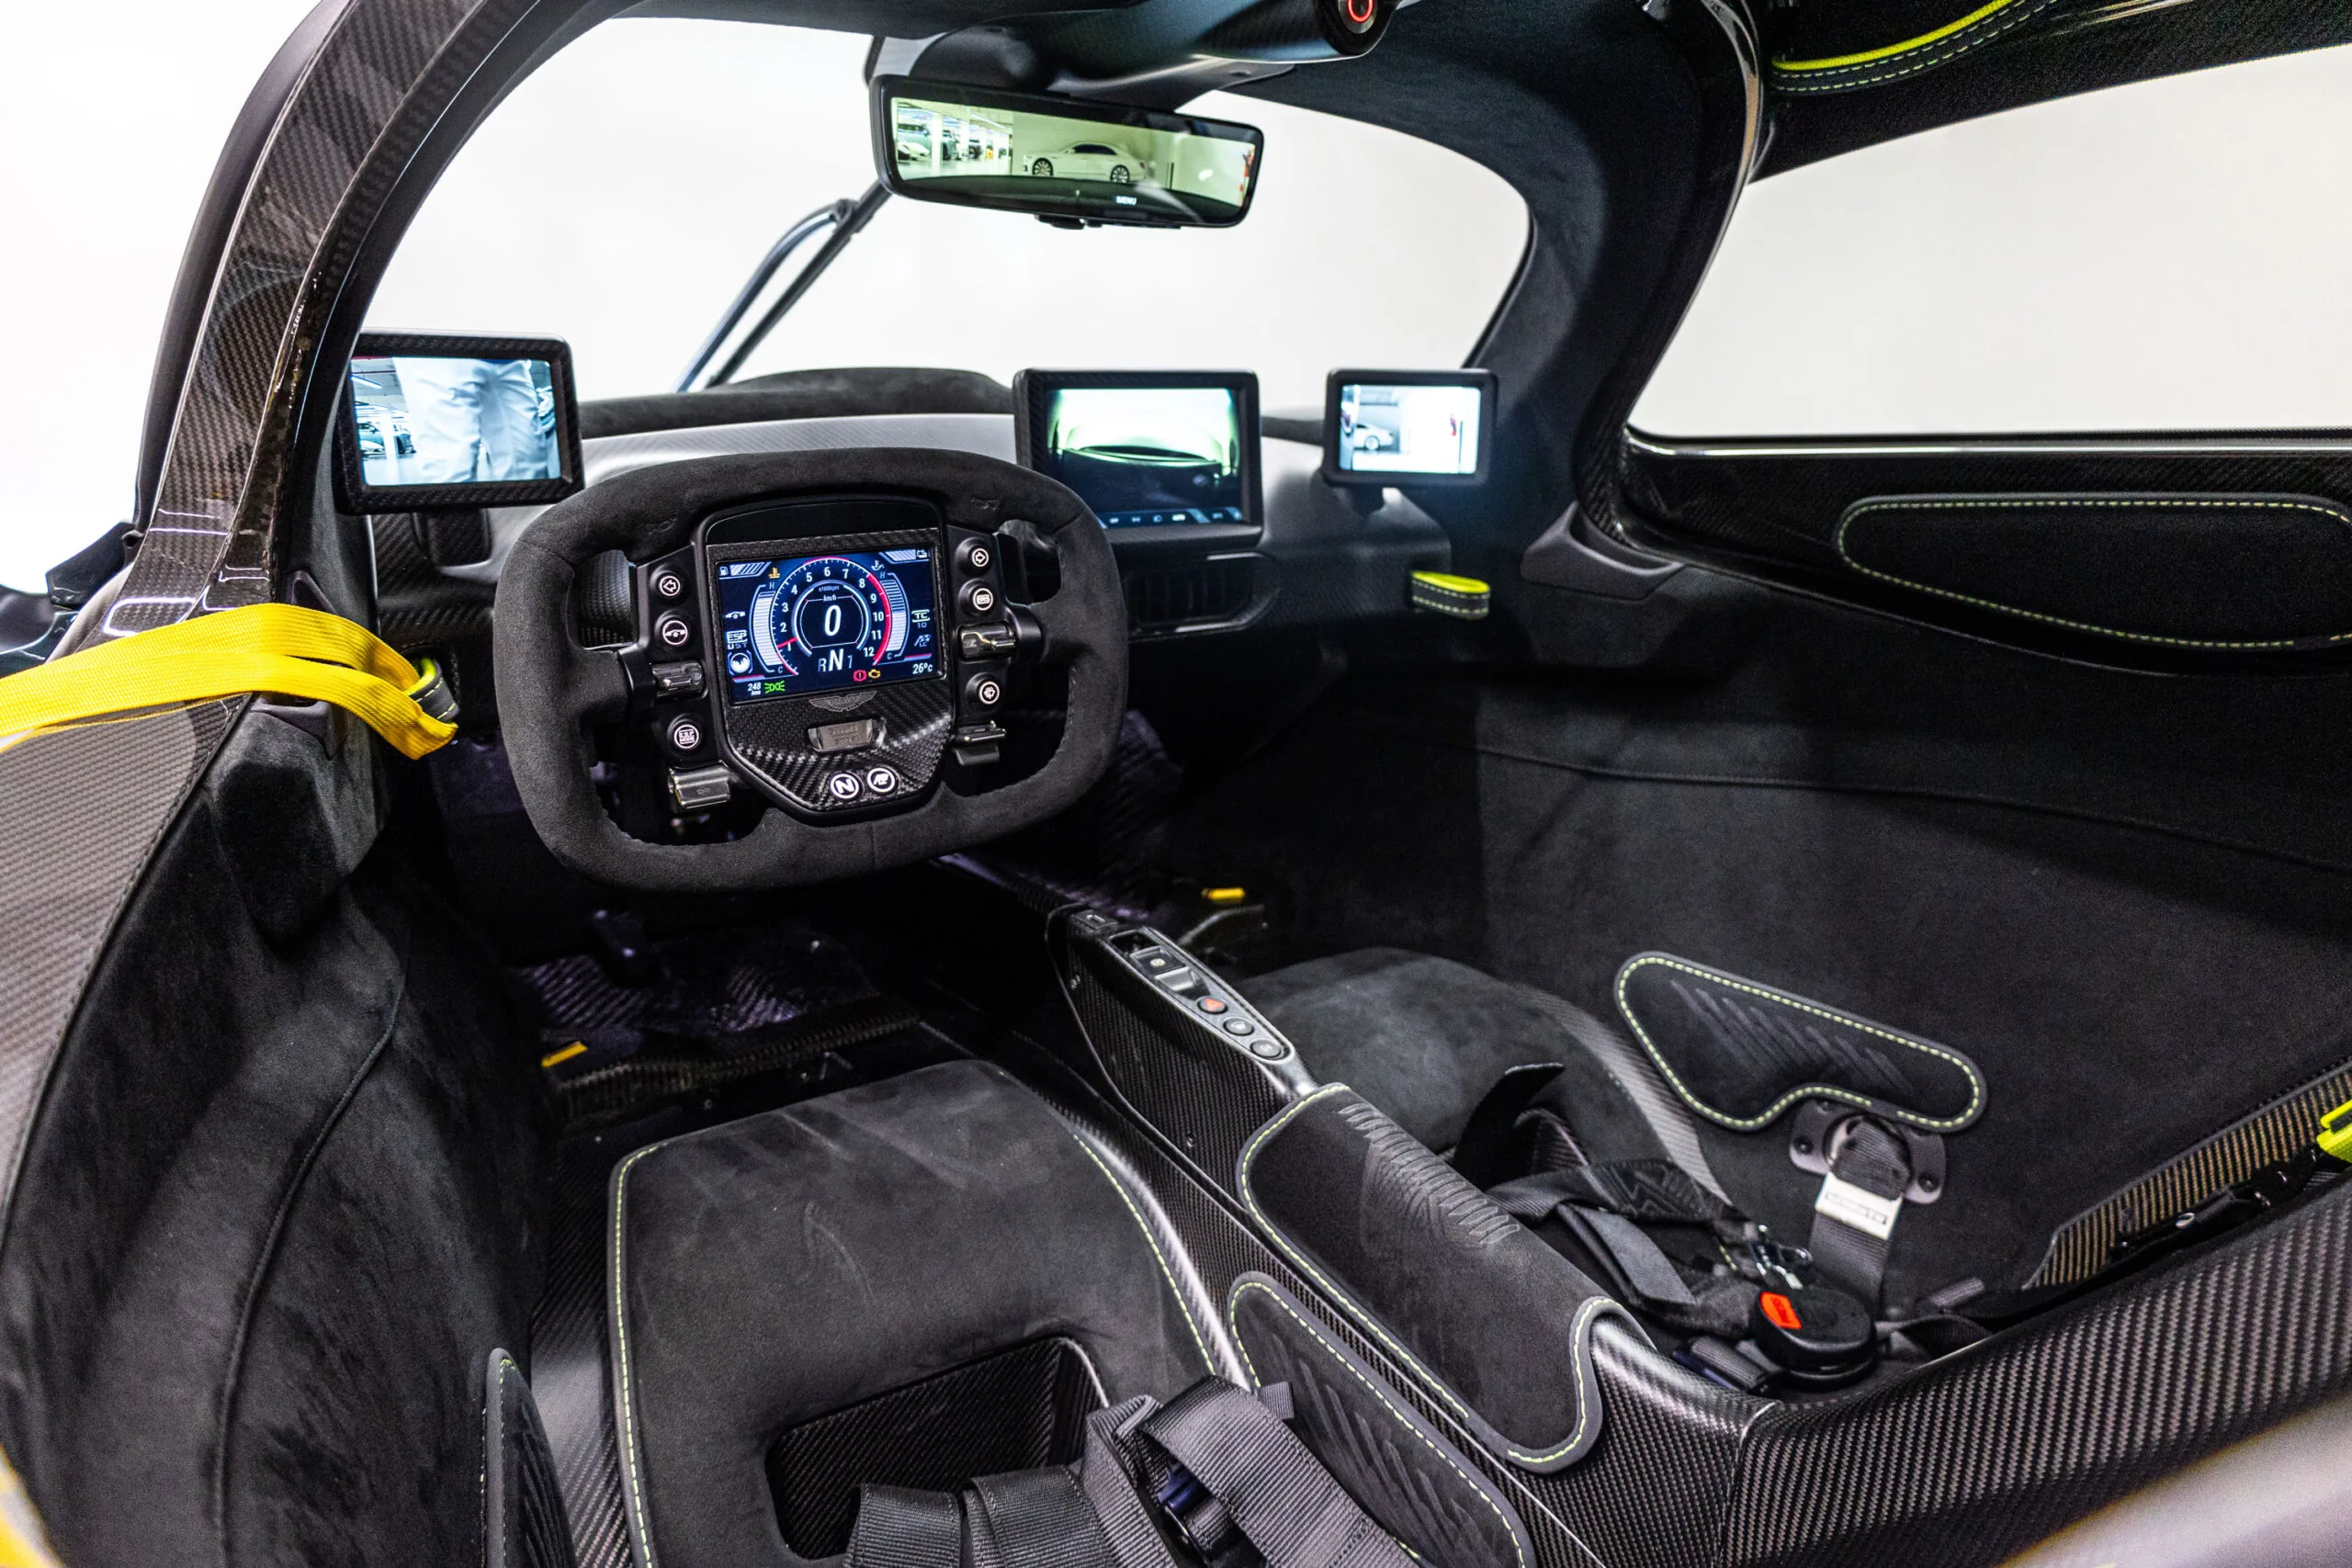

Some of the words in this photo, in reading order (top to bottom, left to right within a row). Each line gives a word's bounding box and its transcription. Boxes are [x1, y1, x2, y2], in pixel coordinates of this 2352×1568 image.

[806, 572, 812, 582] 5
[824, 567, 831, 577] 6
[842, 569, 849, 579] 7
[859, 579, 865, 589] 8
[791, 585, 797, 595] 4
[870, 593, 876, 604] 9
[782, 603, 788, 613] 3
[824, 604, 842, 637] 0
[873, 612, 884, 622] 10
[780, 622, 786, 632] 2
[728, 631, 747, 641] ESP
[871, 630, 881, 640] 11
[864, 647, 875, 657] 12
[818, 658, 827, 672] R
[828, 649, 844, 671] N
[834, 778, 855, 794] N
